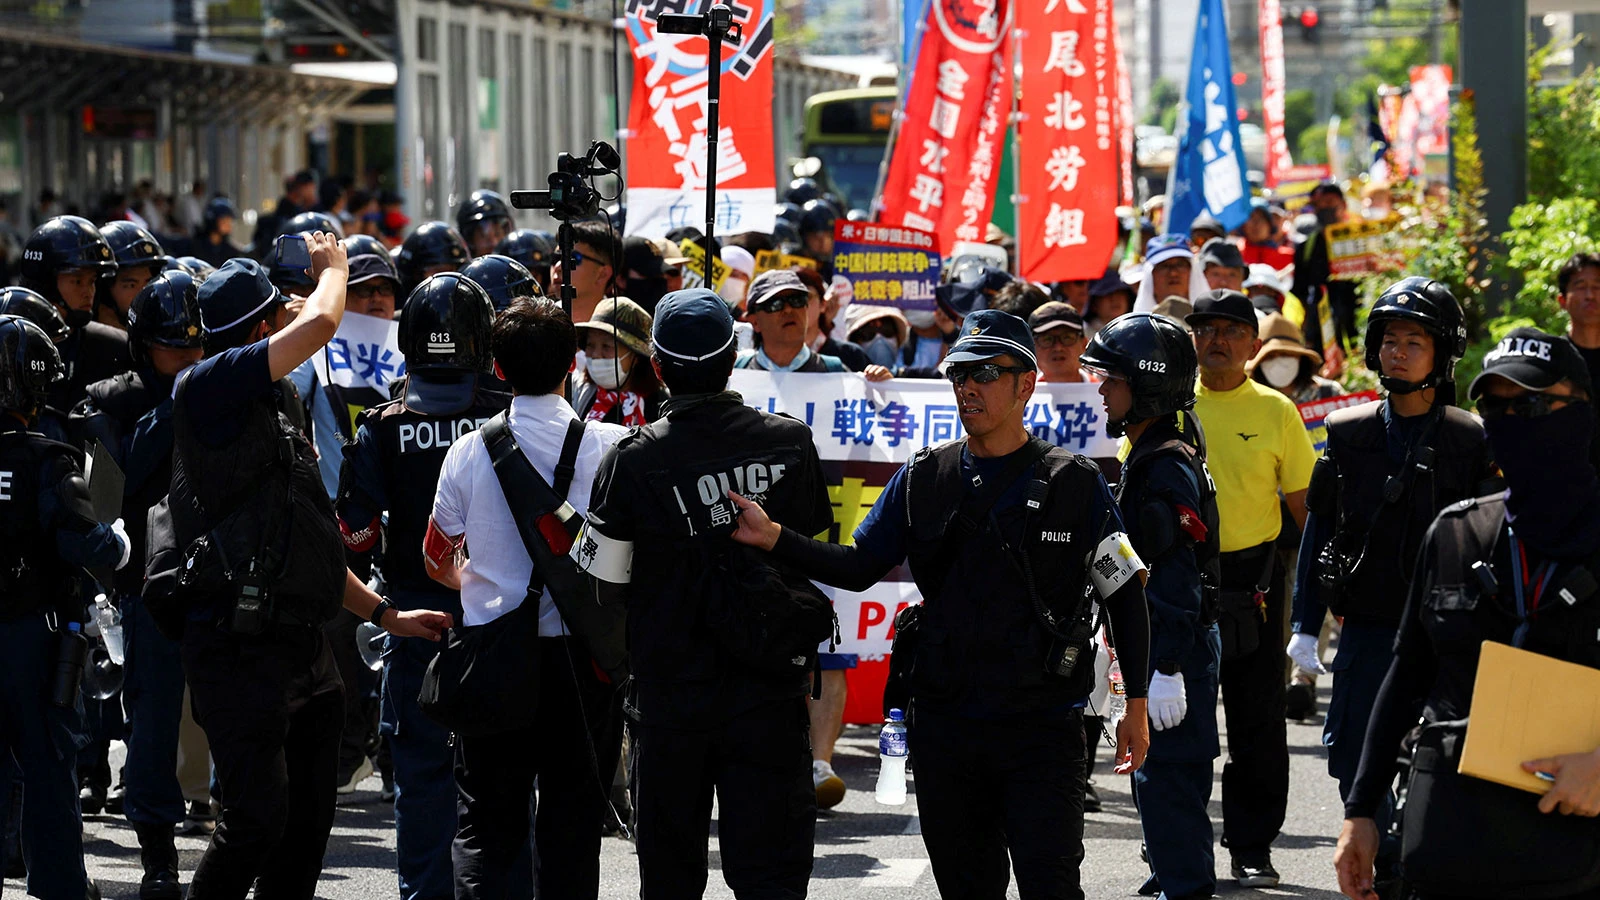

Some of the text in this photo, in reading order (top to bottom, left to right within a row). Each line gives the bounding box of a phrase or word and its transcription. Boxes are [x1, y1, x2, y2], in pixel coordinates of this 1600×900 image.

[430, 333, 451, 343] 613
[31, 360, 46, 371] 613
[327, 337, 406, 387] 日米
[1138, 359, 1167, 373] 6132
[1041, 531, 1072, 542] POLICE
